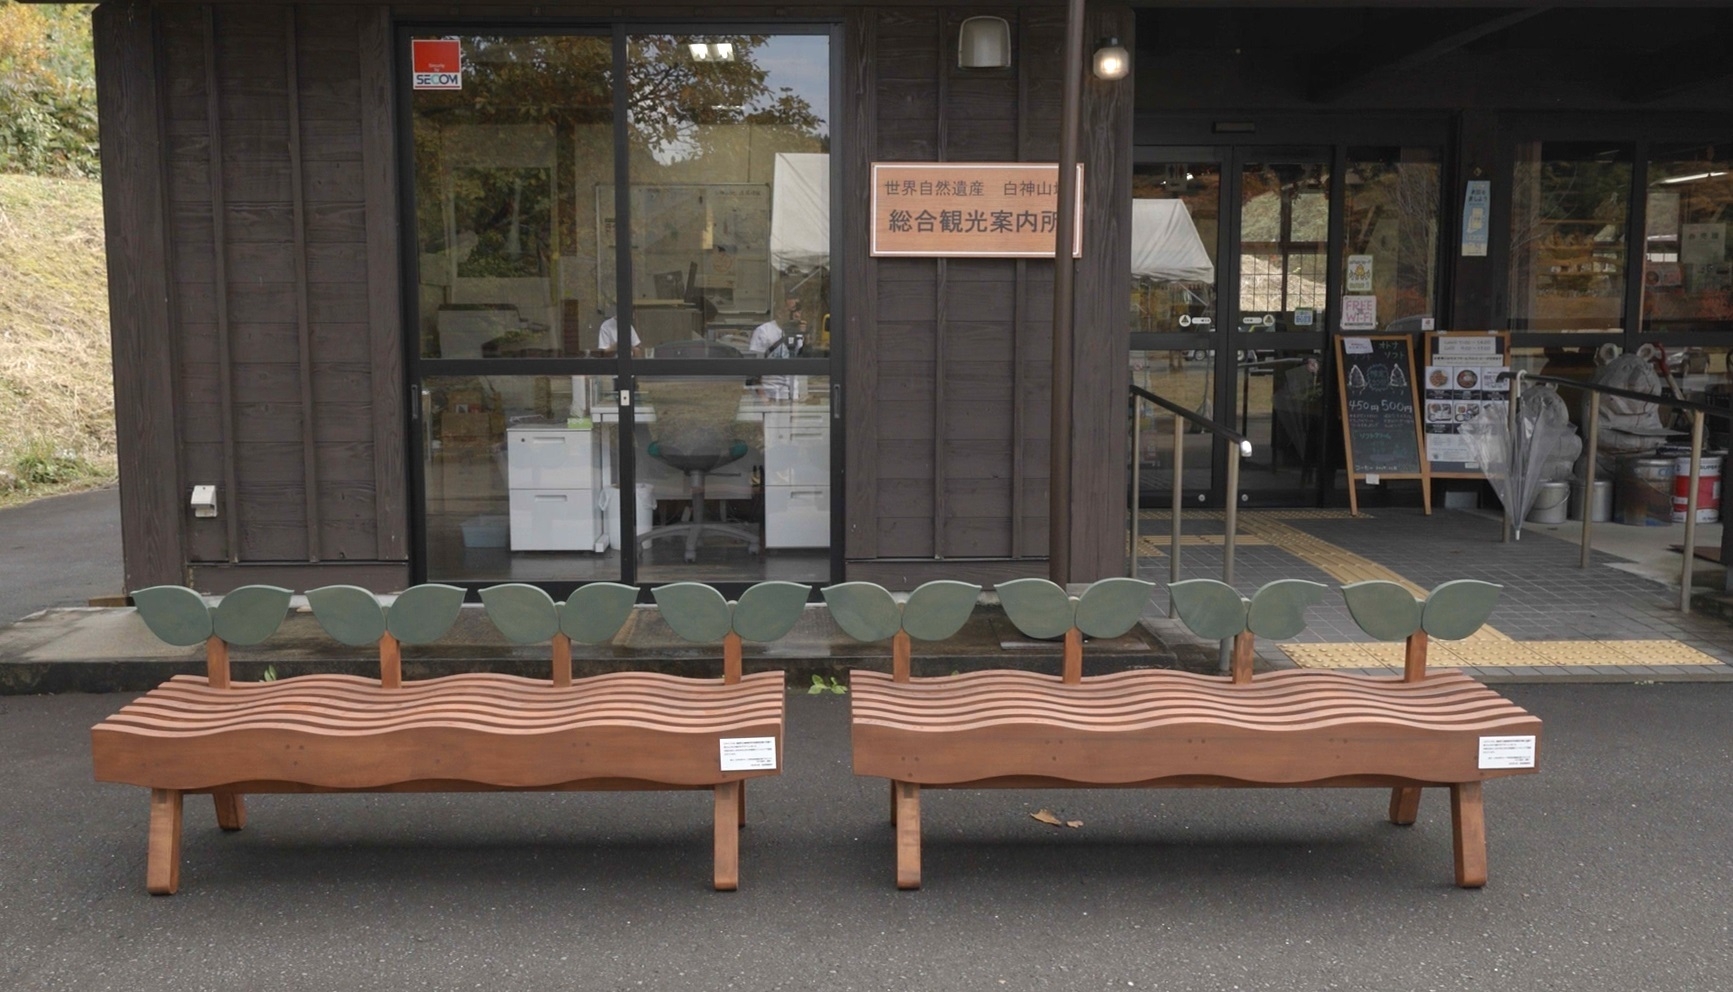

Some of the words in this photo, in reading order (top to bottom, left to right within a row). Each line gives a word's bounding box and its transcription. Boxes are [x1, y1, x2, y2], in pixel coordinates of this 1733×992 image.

[416, 74, 458, 85] SECOM
[884, 179, 985, 197] 世界自然遺産
[888, 209, 1058, 234] 総合観光案内所
[1345, 300, 1373, 311] FREE
[1345, 311, 1373, 322] Wi-Fi
[1348, 400, 1379, 412] 450円
[1381, 399, 1413, 413] 500円
